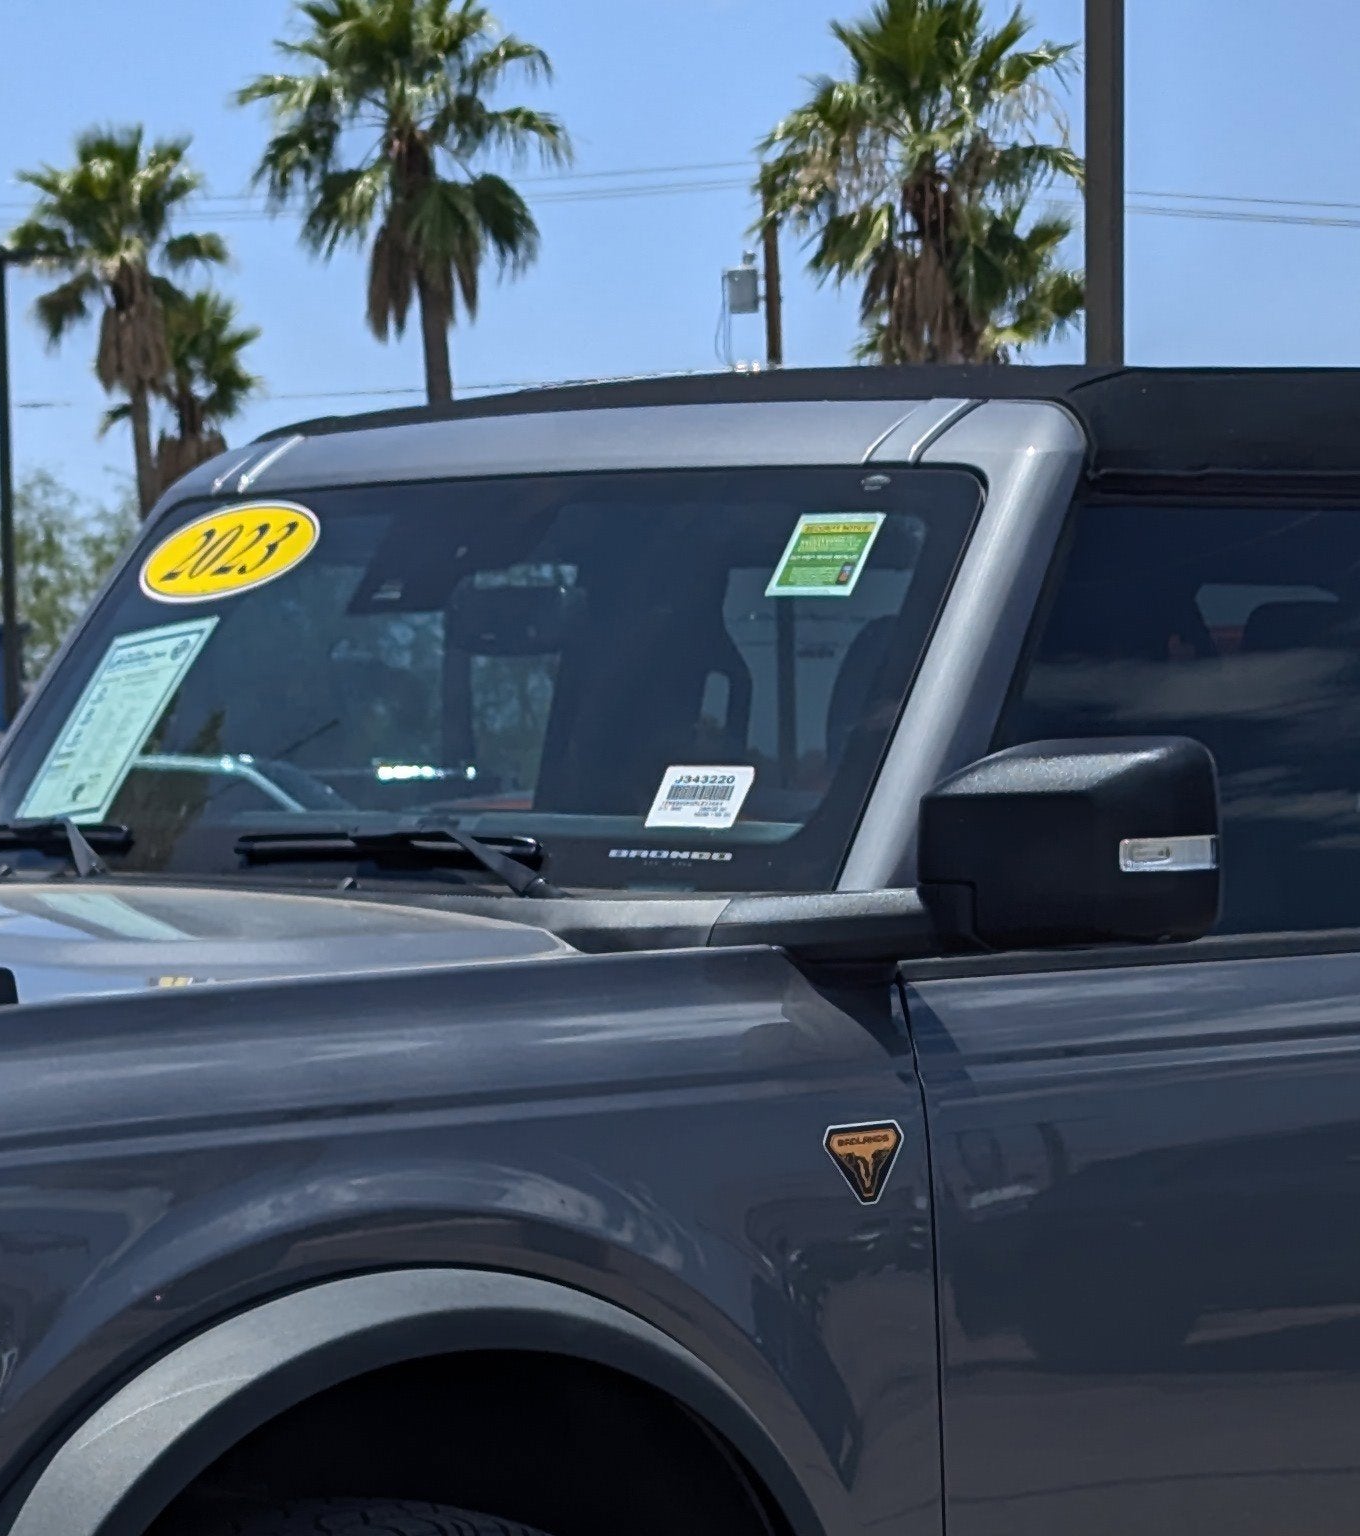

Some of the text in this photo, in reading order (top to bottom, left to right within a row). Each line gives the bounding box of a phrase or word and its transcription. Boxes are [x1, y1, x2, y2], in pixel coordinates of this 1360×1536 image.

[159, 520, 299, 583] 2023
[674, 774, 736, 785] J343220
[608, 848, 733, 861] BRONCO
[837, 1134, 890, 1147] BADLANDS
